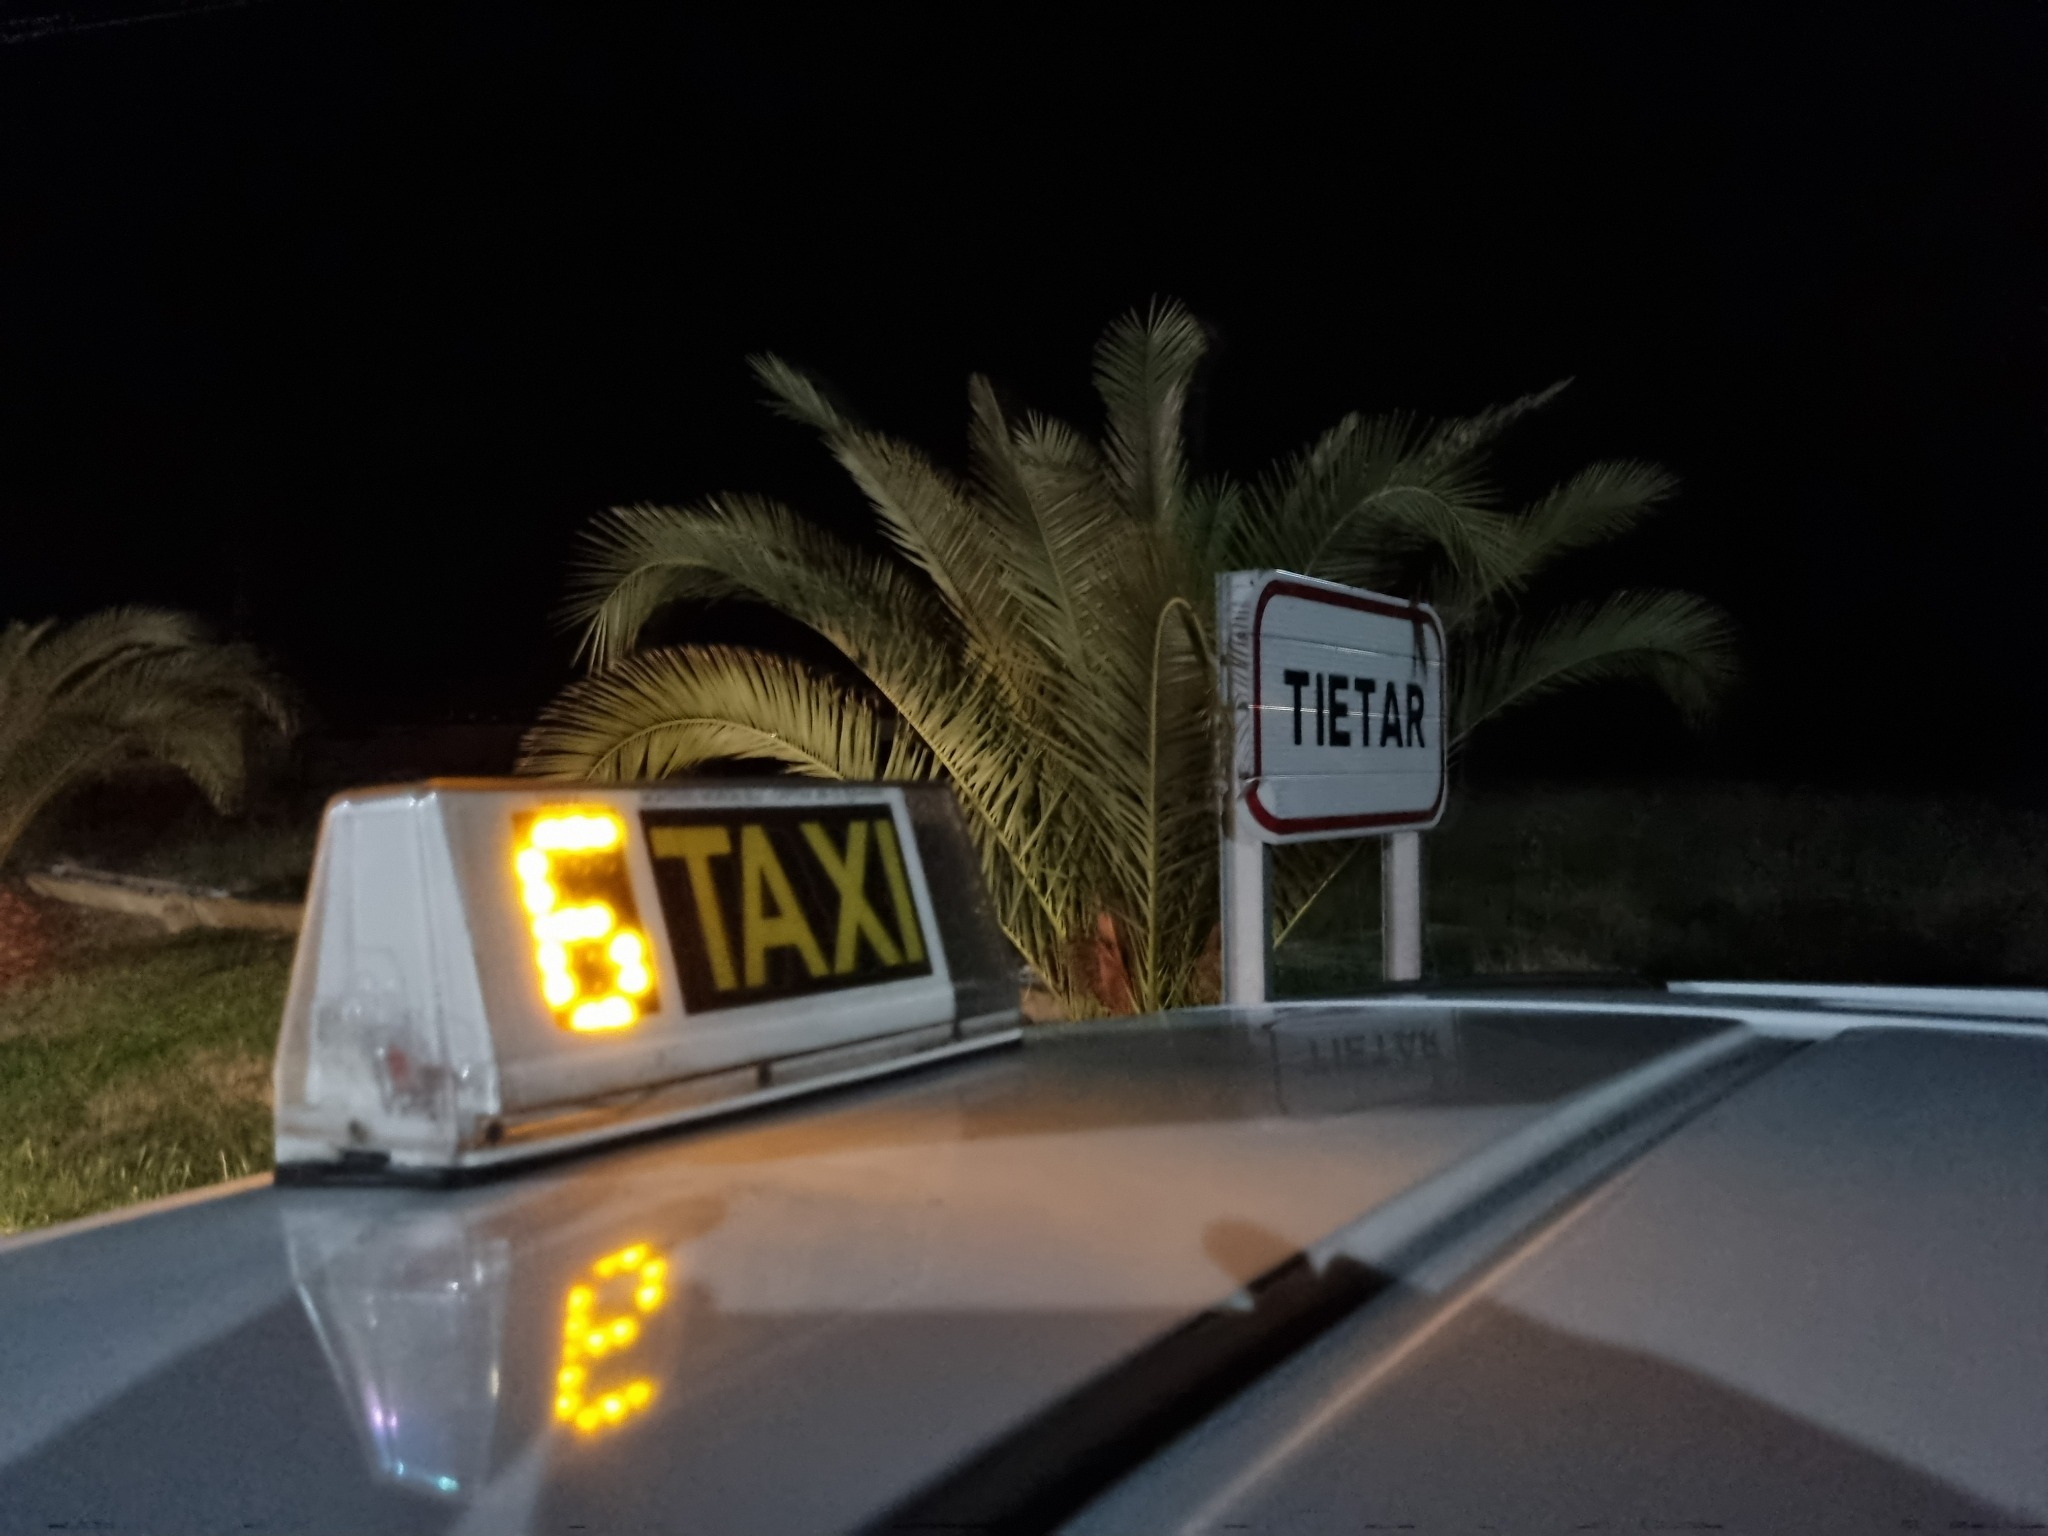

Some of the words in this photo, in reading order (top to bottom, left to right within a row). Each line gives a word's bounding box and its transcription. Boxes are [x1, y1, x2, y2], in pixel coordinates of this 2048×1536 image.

[1283, 669, 1426, 747] TIETAR
[515, 809, 653, 1031] 6
[653, 820, 925, 991] TAXI
